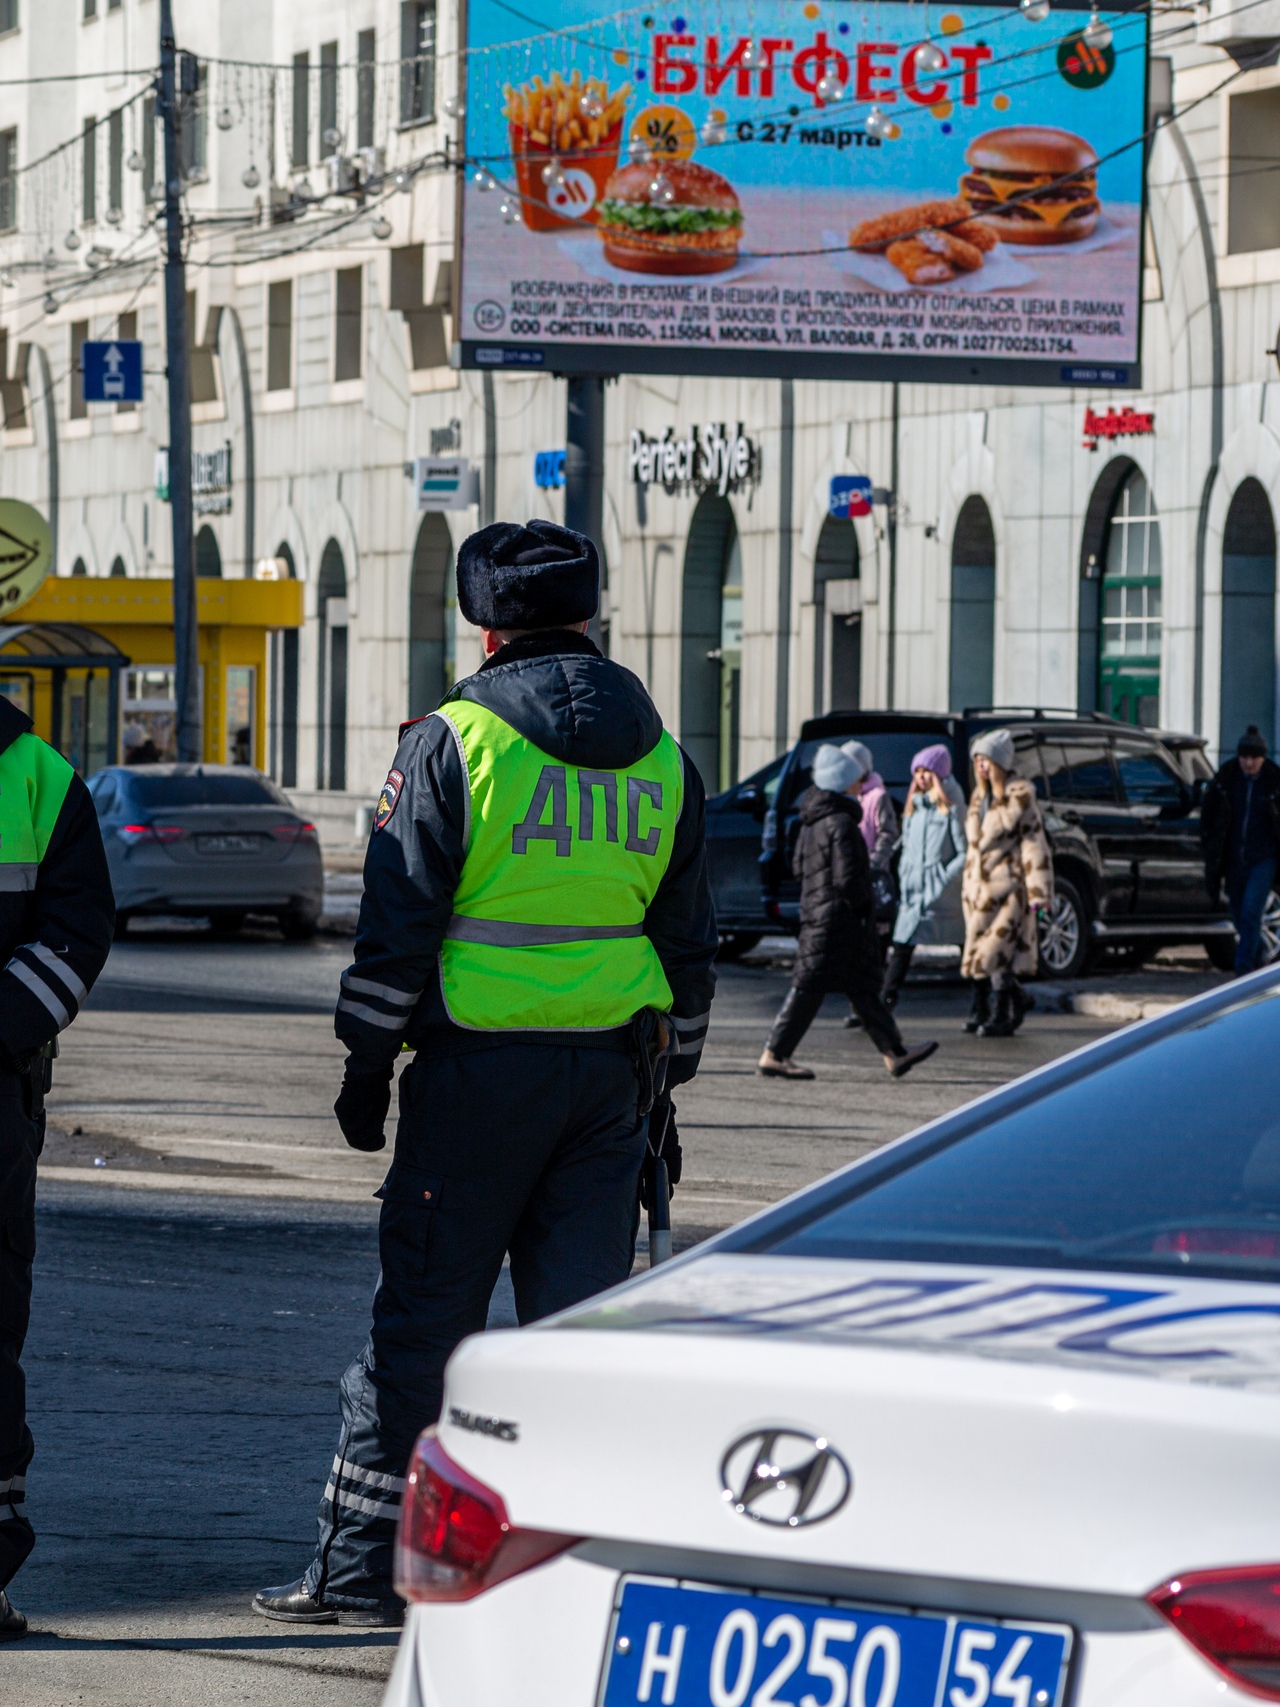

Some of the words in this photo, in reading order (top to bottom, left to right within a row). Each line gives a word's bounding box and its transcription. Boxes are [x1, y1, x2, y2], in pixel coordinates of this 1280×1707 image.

[652, 32, 992, 107] БИГФЕСТ
[759, 123, 792, 143] 27
[799, 126, 882, 150] марта
[511, 281, 613, 299] ИЗОБРАЖЕНИЯ
[631, 285, 693, 301] РЕКЛАМЕ
[711, 286, 780, 304] ВНЕШНИЙ
[815, 290, 880, 309] ПРОДУКТА
[885, 293, 927, 310] МОГУТ
[1021, 298, 1057, 315] ЦЕНА
[1073, 300, 1125, 316] РАМКАХ
[561, 301, 675, 319] ДЕЙСТВИТЕЛЬНА
[680, 305, 710, 322] ДЛЯ
[715, 306, 776, 323] ЗАКАЗОВ
[511, 319, 541, 335] ООО
[720, 327, 782, 344] МОСКВА,
[923, 333, 959, 350] ОГРН
[629, 424, 696, 483] Perfect
[699, 421, 750, 497] Style
[513, 765, 663, 857] ДПС
[708, 1608, 901, 1707] 0250
[949, 1628, 1033, 1707] 54
